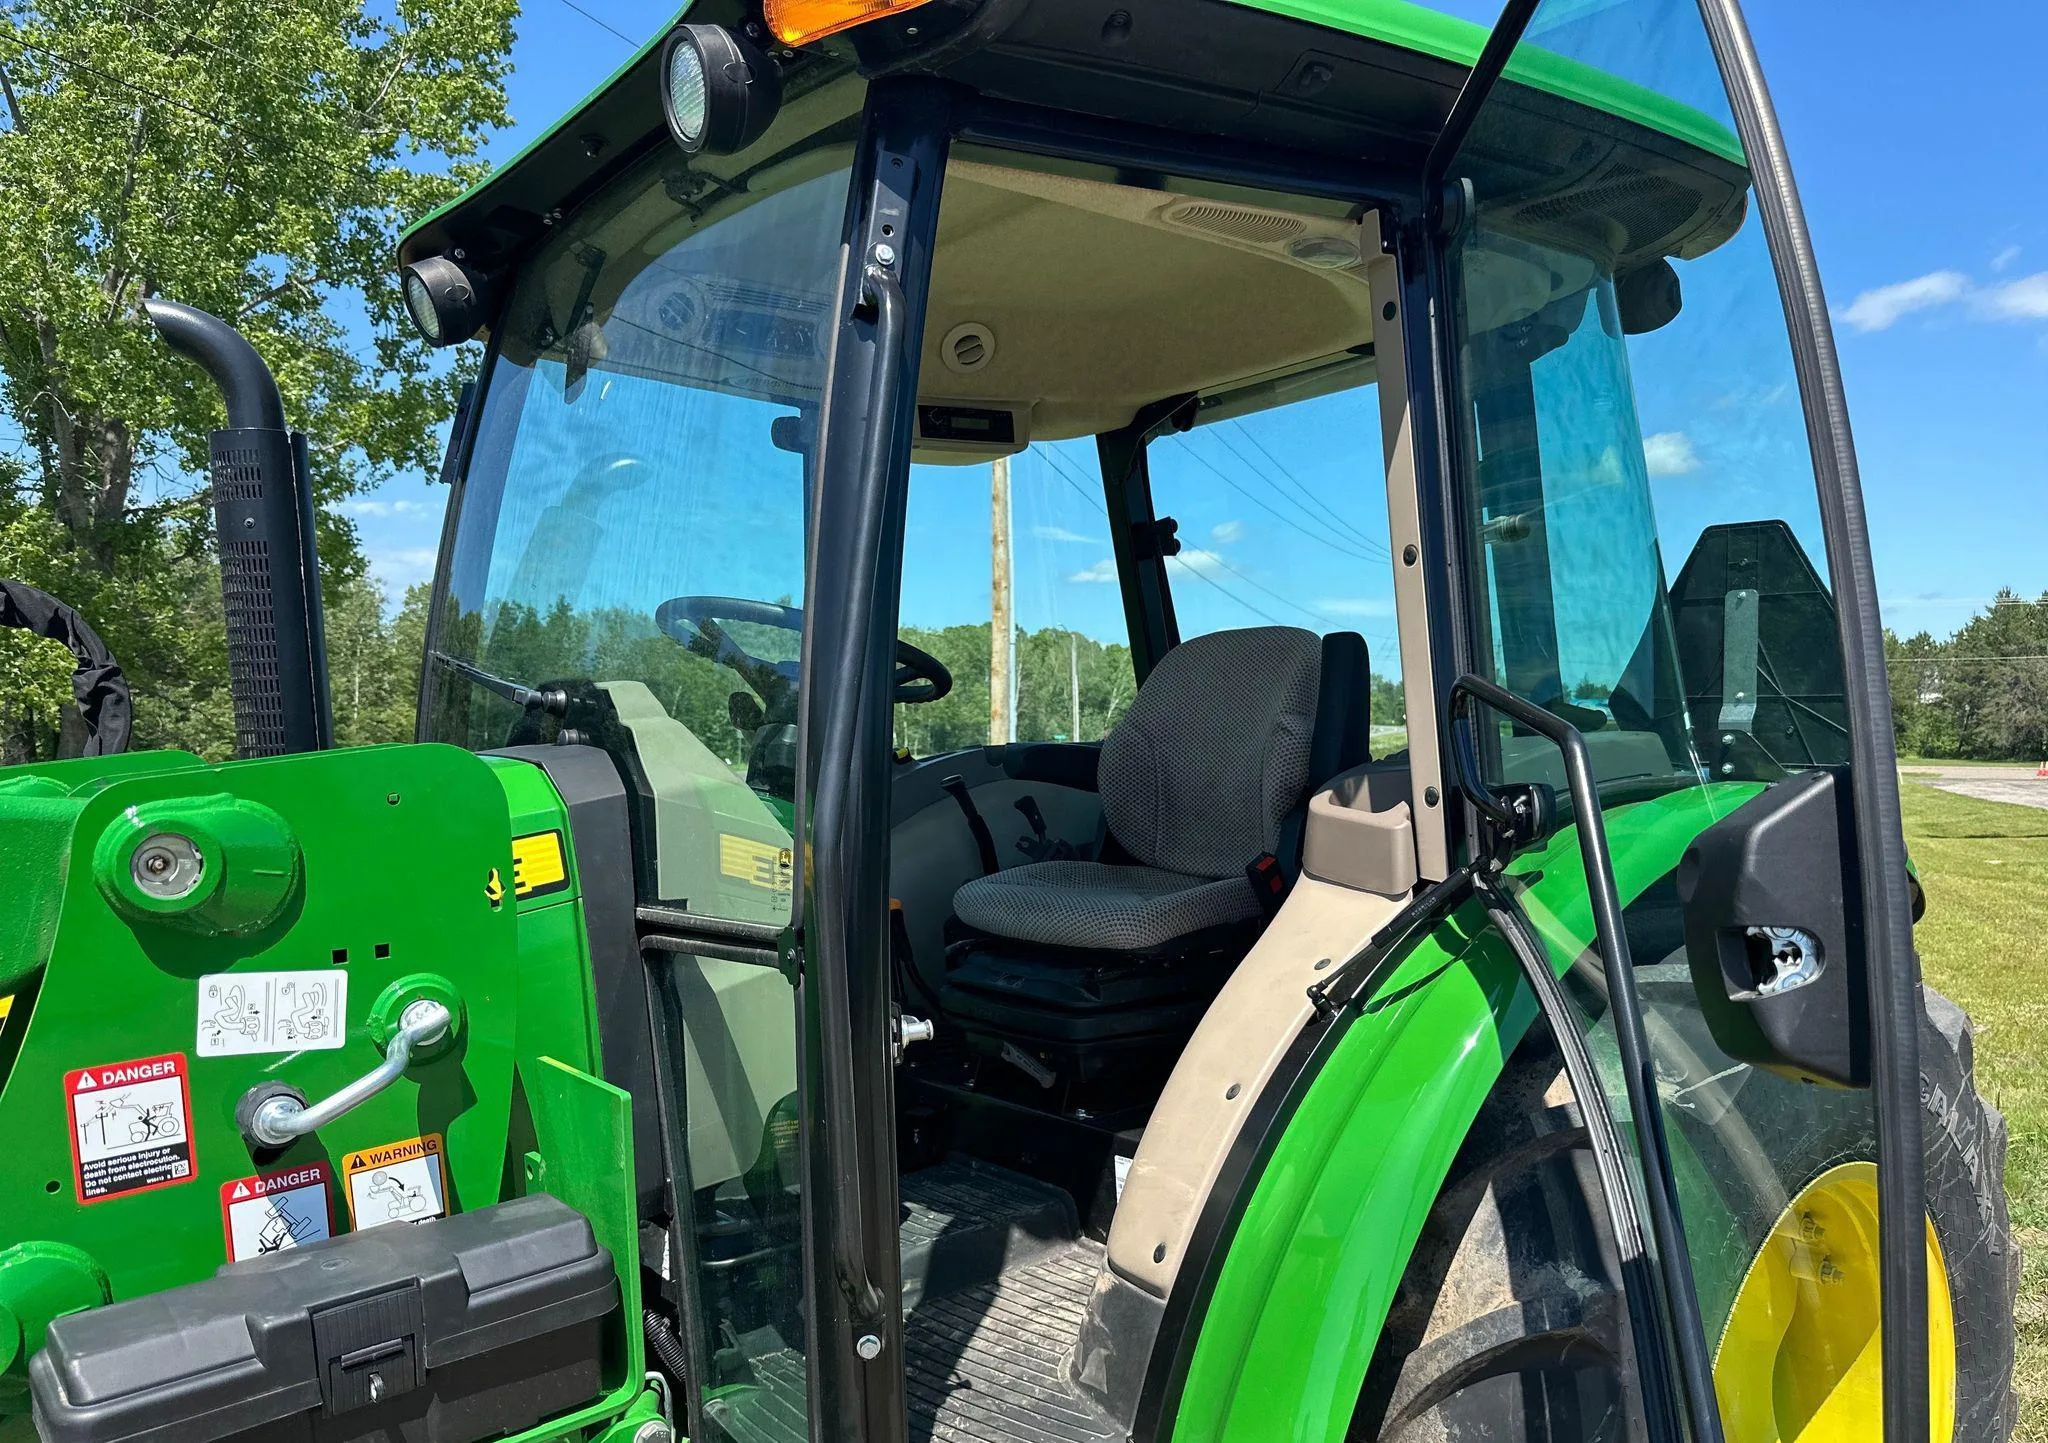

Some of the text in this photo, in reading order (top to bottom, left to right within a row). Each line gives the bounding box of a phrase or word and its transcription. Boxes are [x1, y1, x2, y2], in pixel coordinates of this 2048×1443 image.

[101, 1061, 176, 1085] DANGER
[83, 1147, 171, 1171] Avoid serious injury or
[369, 1139, 438, 1165] WARNING
[84, 1154, 181, 1180] death from electrocution.
[85, 1180, 97, 1188] Do
[98, 1175, 112, 1185] not
[113, 1169, 143, 1181] contact
[143, 1164, 172, 1176] electric
[86, 1188, 108, 1197] lines.
[254, 1168, 321, 1194] DANGER
